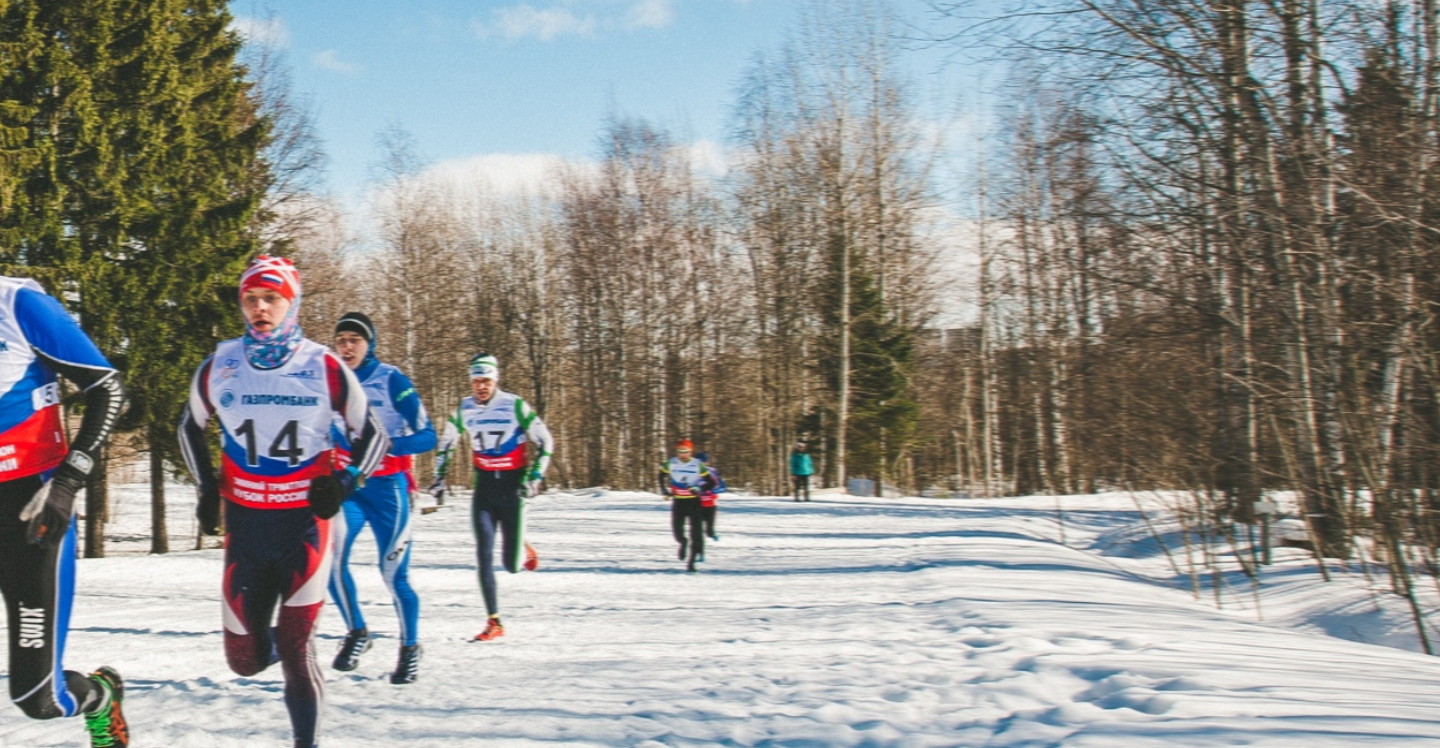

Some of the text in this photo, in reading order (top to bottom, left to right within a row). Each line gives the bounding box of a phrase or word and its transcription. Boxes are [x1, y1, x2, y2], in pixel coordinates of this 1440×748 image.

[242, 394, 319, 407] ГАЗПРОМБАНК
[234, 419, 304, 467] 14
[474, 431, 505, 453] 17
[19, 607, 46, 649] SWIX
